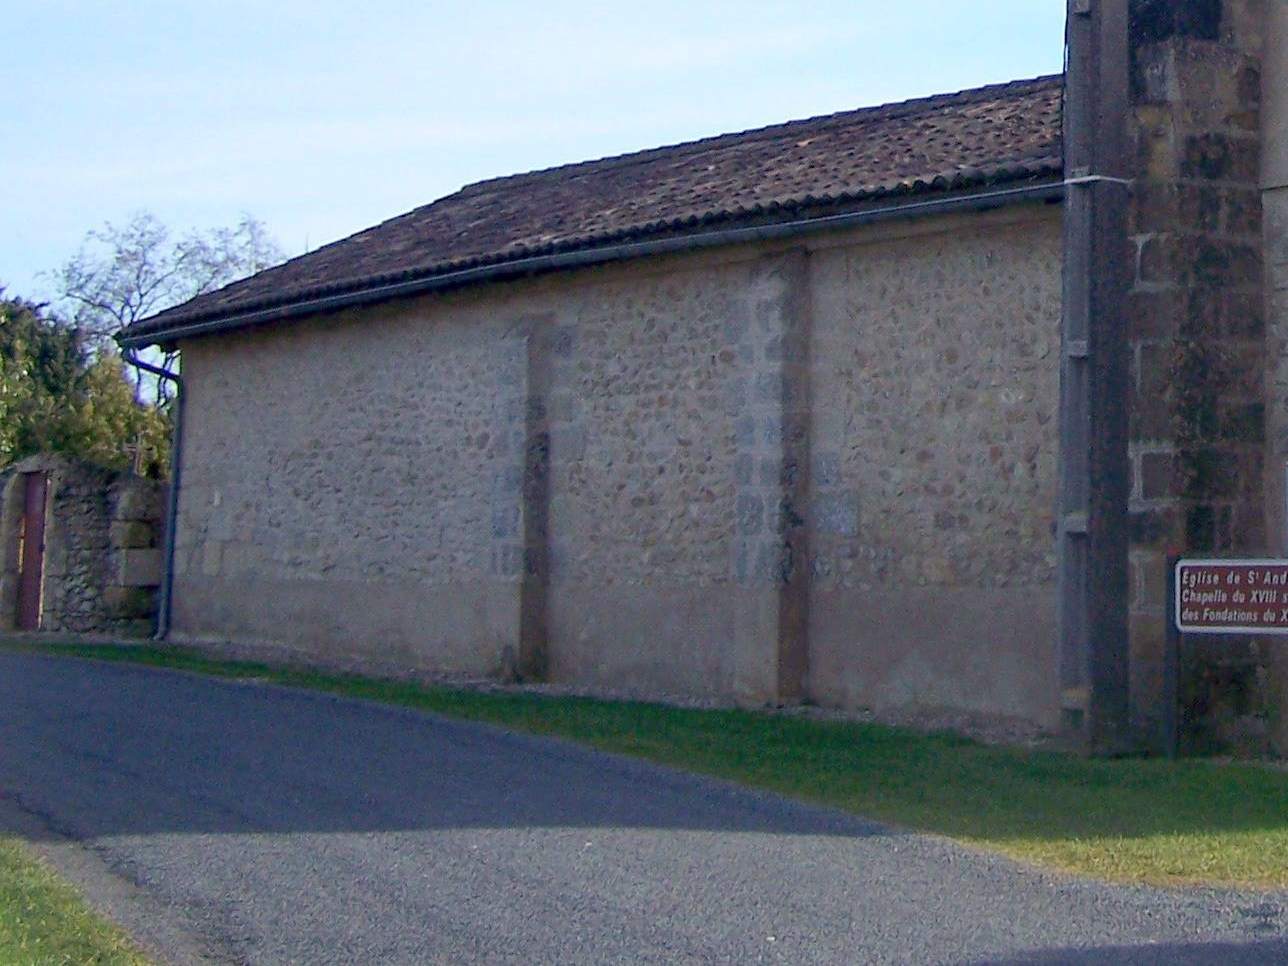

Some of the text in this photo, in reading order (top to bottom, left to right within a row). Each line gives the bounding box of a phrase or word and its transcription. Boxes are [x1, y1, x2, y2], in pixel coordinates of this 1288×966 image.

[1226, 570, 1240, 585] de
[1182, 589, 1227, 605] Chapelle
[1232, 590, 1246, 603] du
[1250, 590, 1277, 603] XVIII
[1182, 608, 1199, 621] des
[1202, 608, 1258, 622] Fondations
[1263, 609, 1275, 622] du
